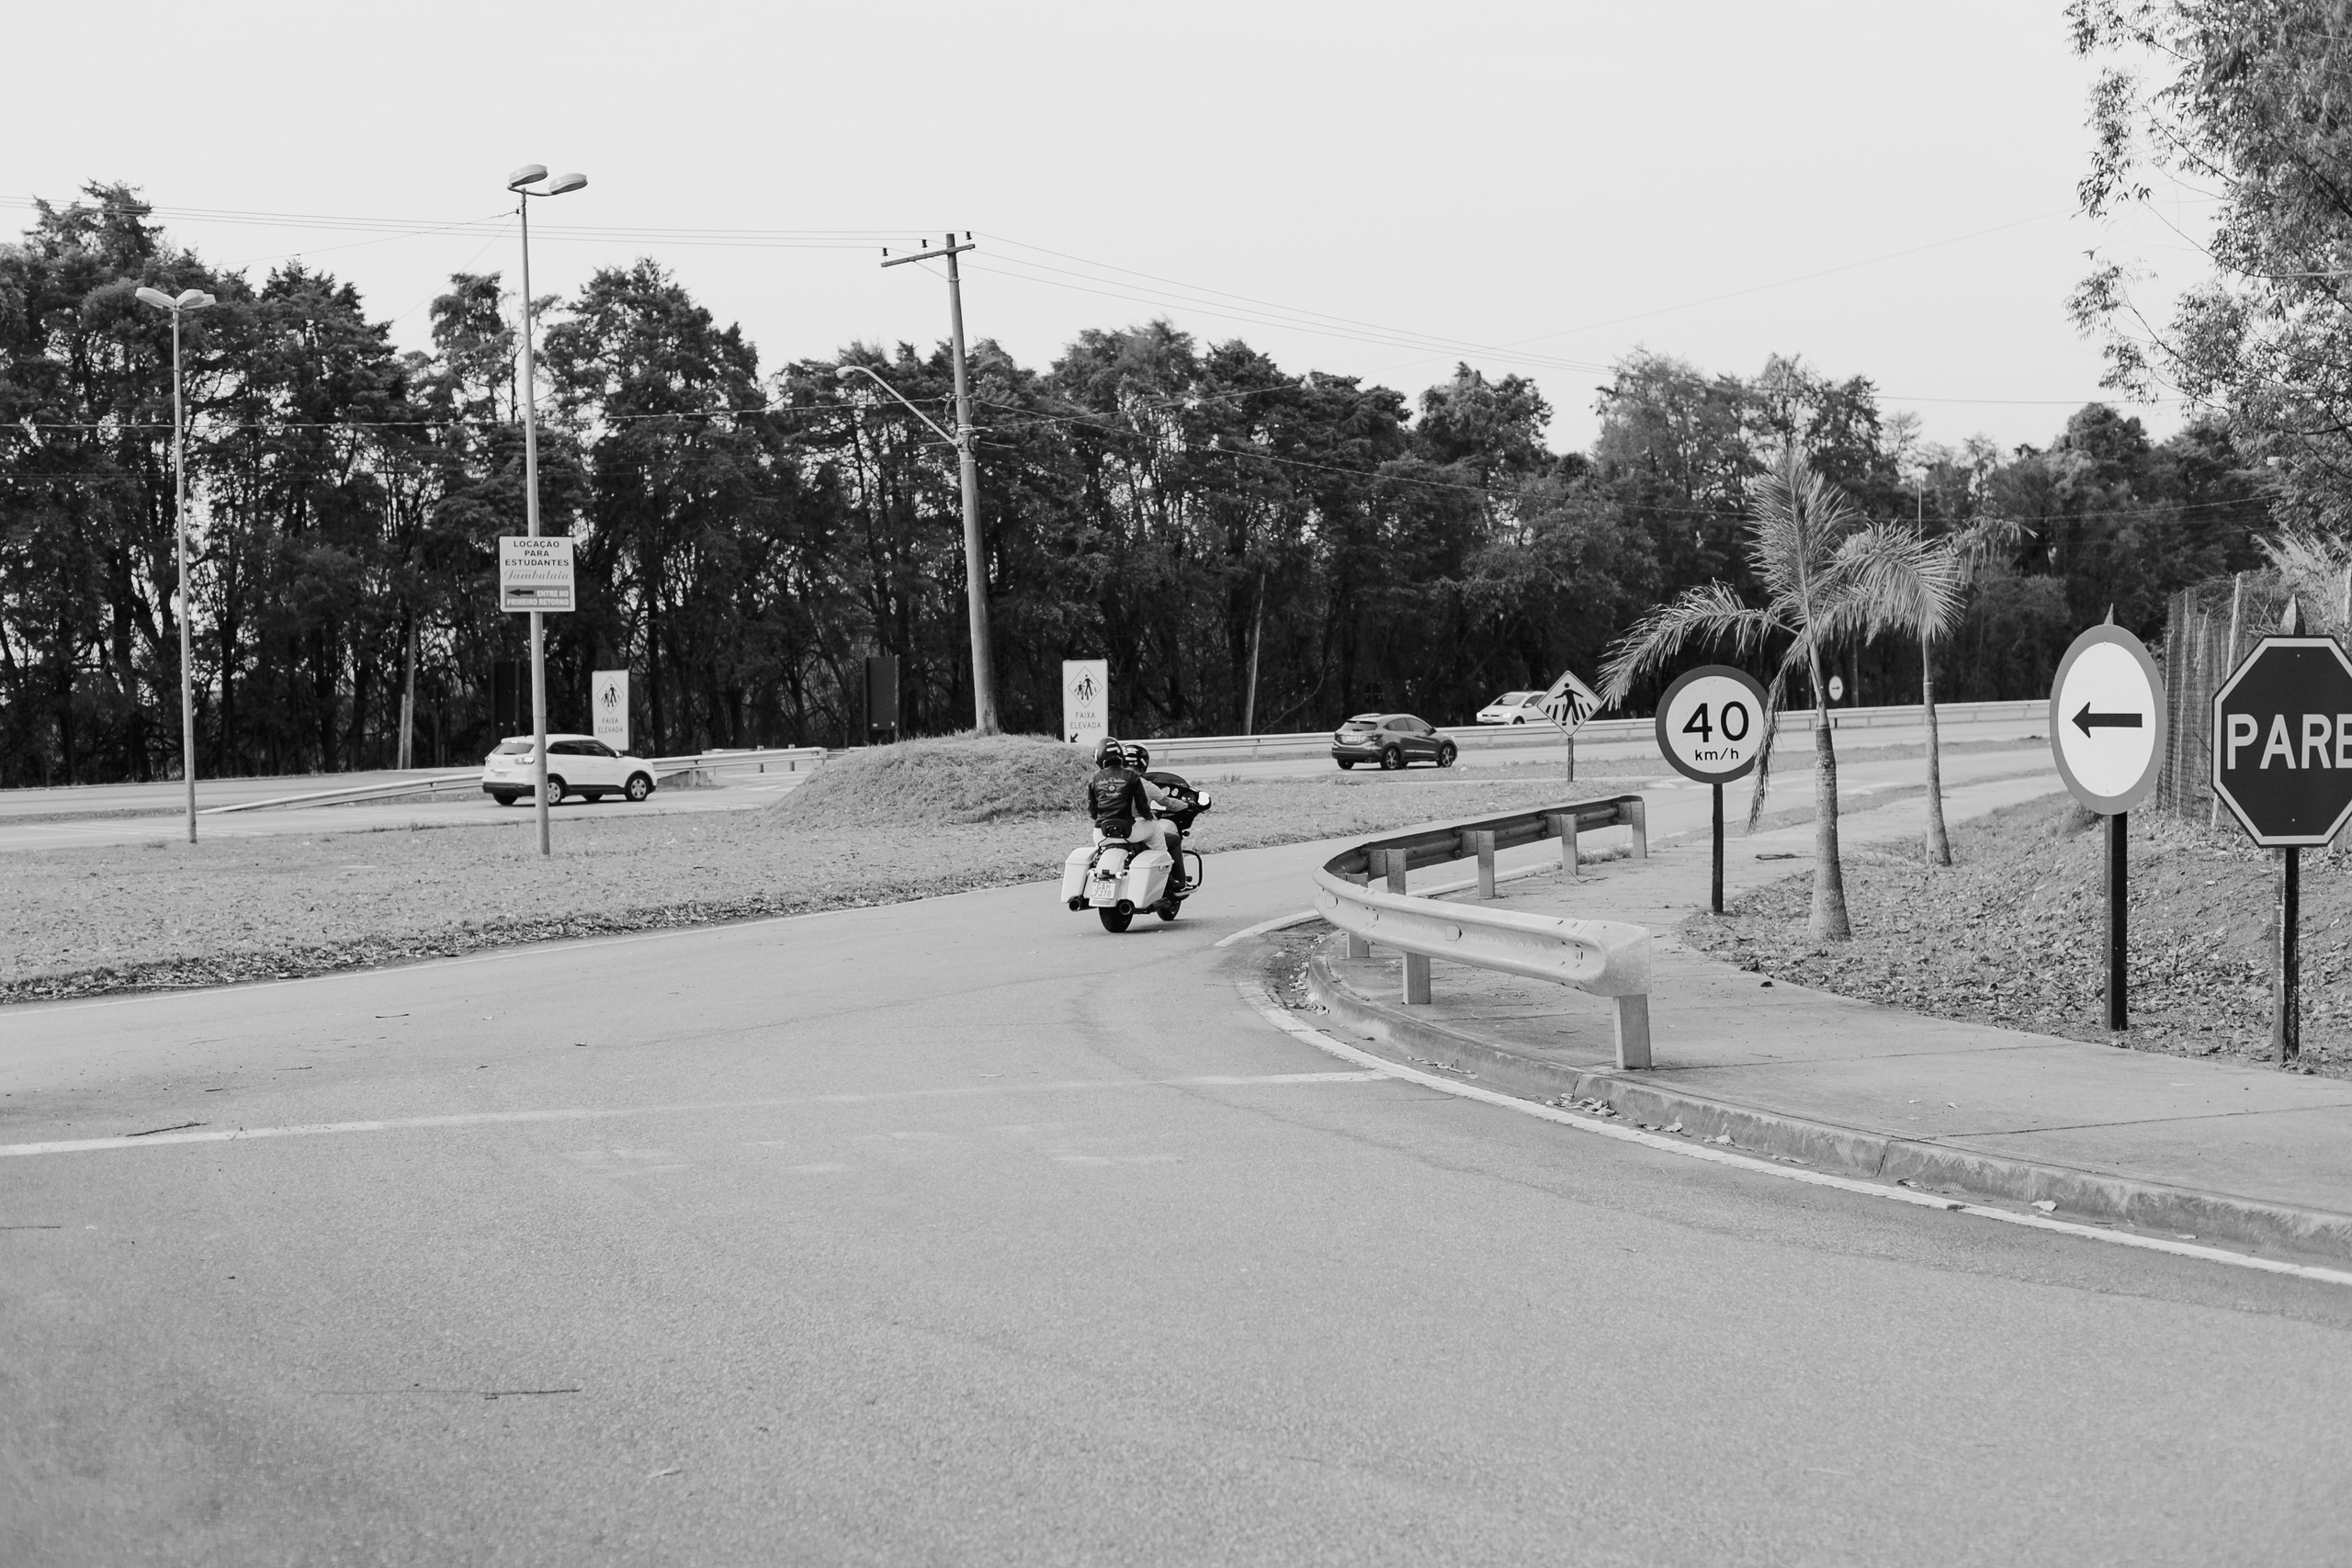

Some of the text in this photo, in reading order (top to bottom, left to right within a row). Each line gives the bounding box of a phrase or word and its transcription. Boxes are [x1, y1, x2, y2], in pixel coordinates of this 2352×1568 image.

[1069, 721, 1102, 729] ELEVADA
[1682, 701, 1749, 742] 40
[598, 726, 623, 734] ELEVADA
[2227, 713, 2352, 770] PARE
[1694, 748, 1739, 761] km/h
